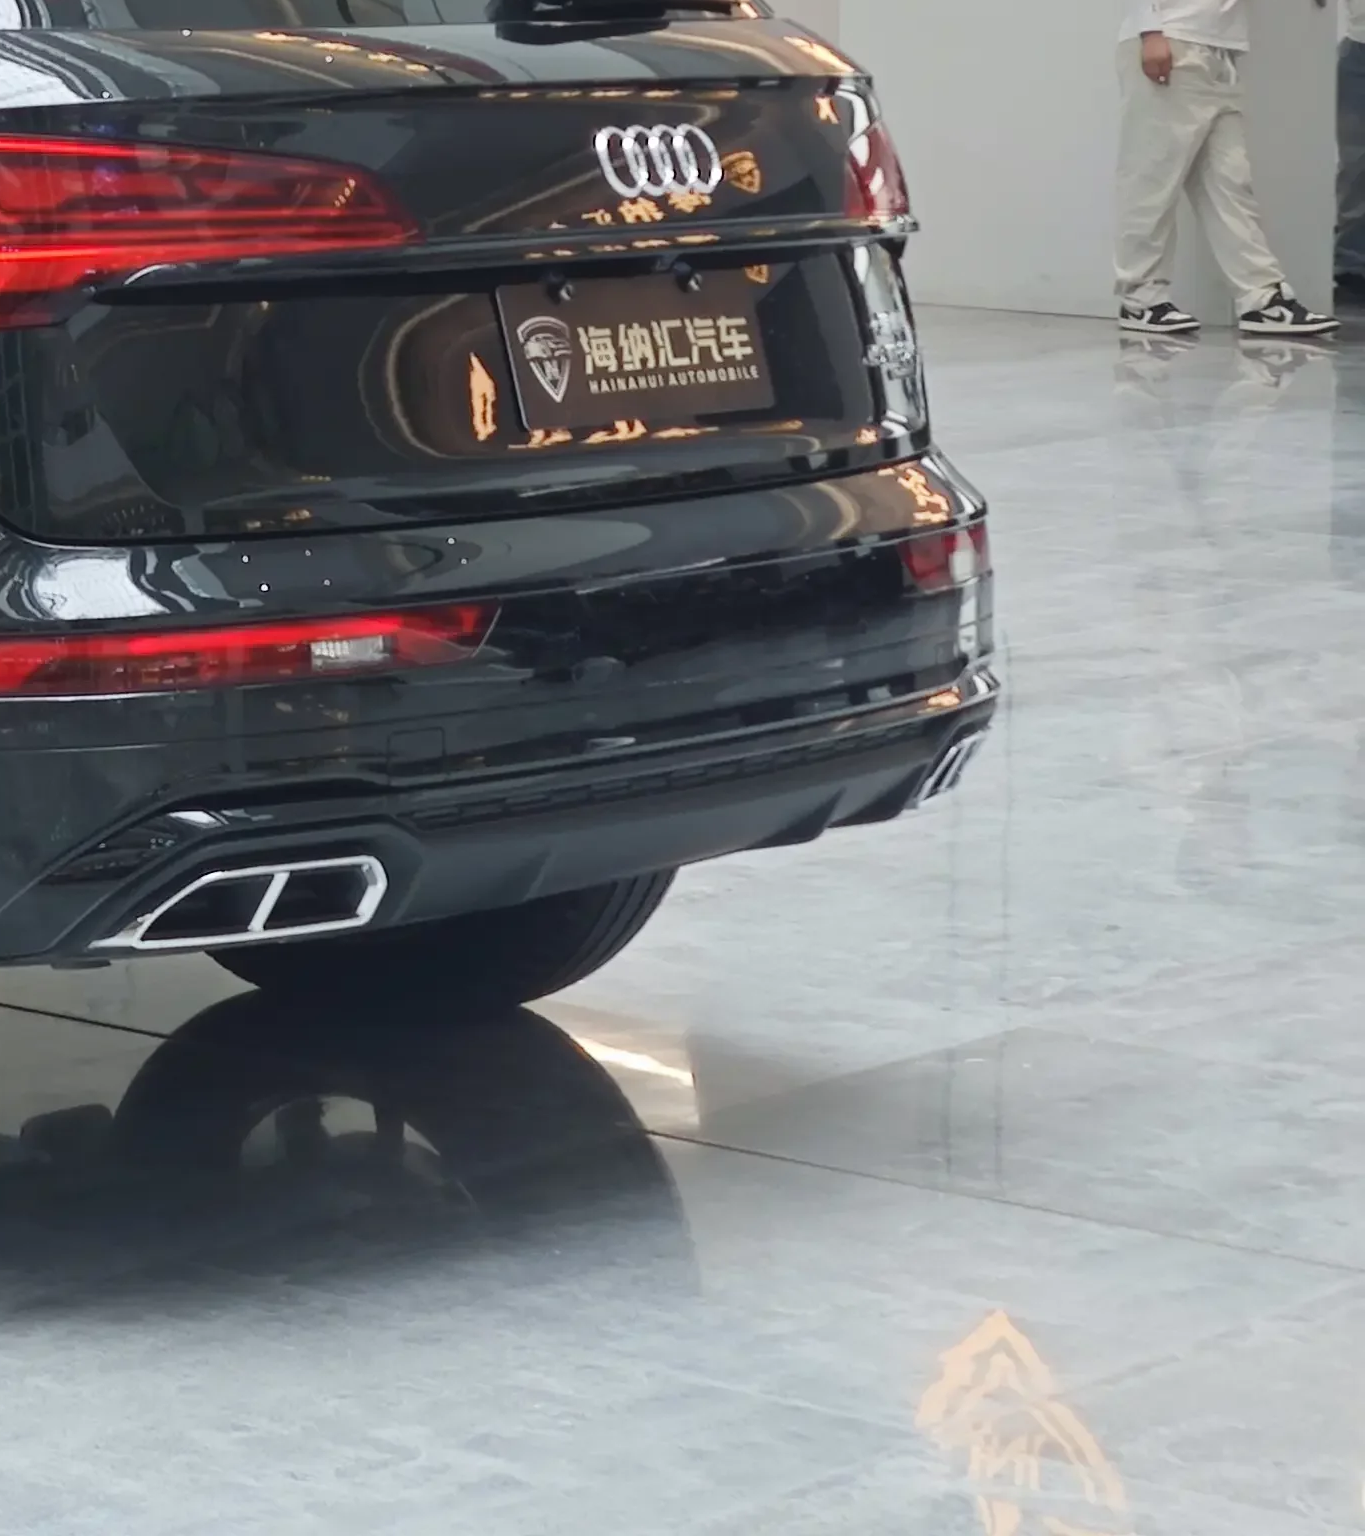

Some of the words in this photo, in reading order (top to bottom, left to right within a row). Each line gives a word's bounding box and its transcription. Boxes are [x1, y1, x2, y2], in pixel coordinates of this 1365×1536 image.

[576, 315, 754, 375] 海纳汇汽车
[669, 364, 761, 388] AUTOMOBILE
